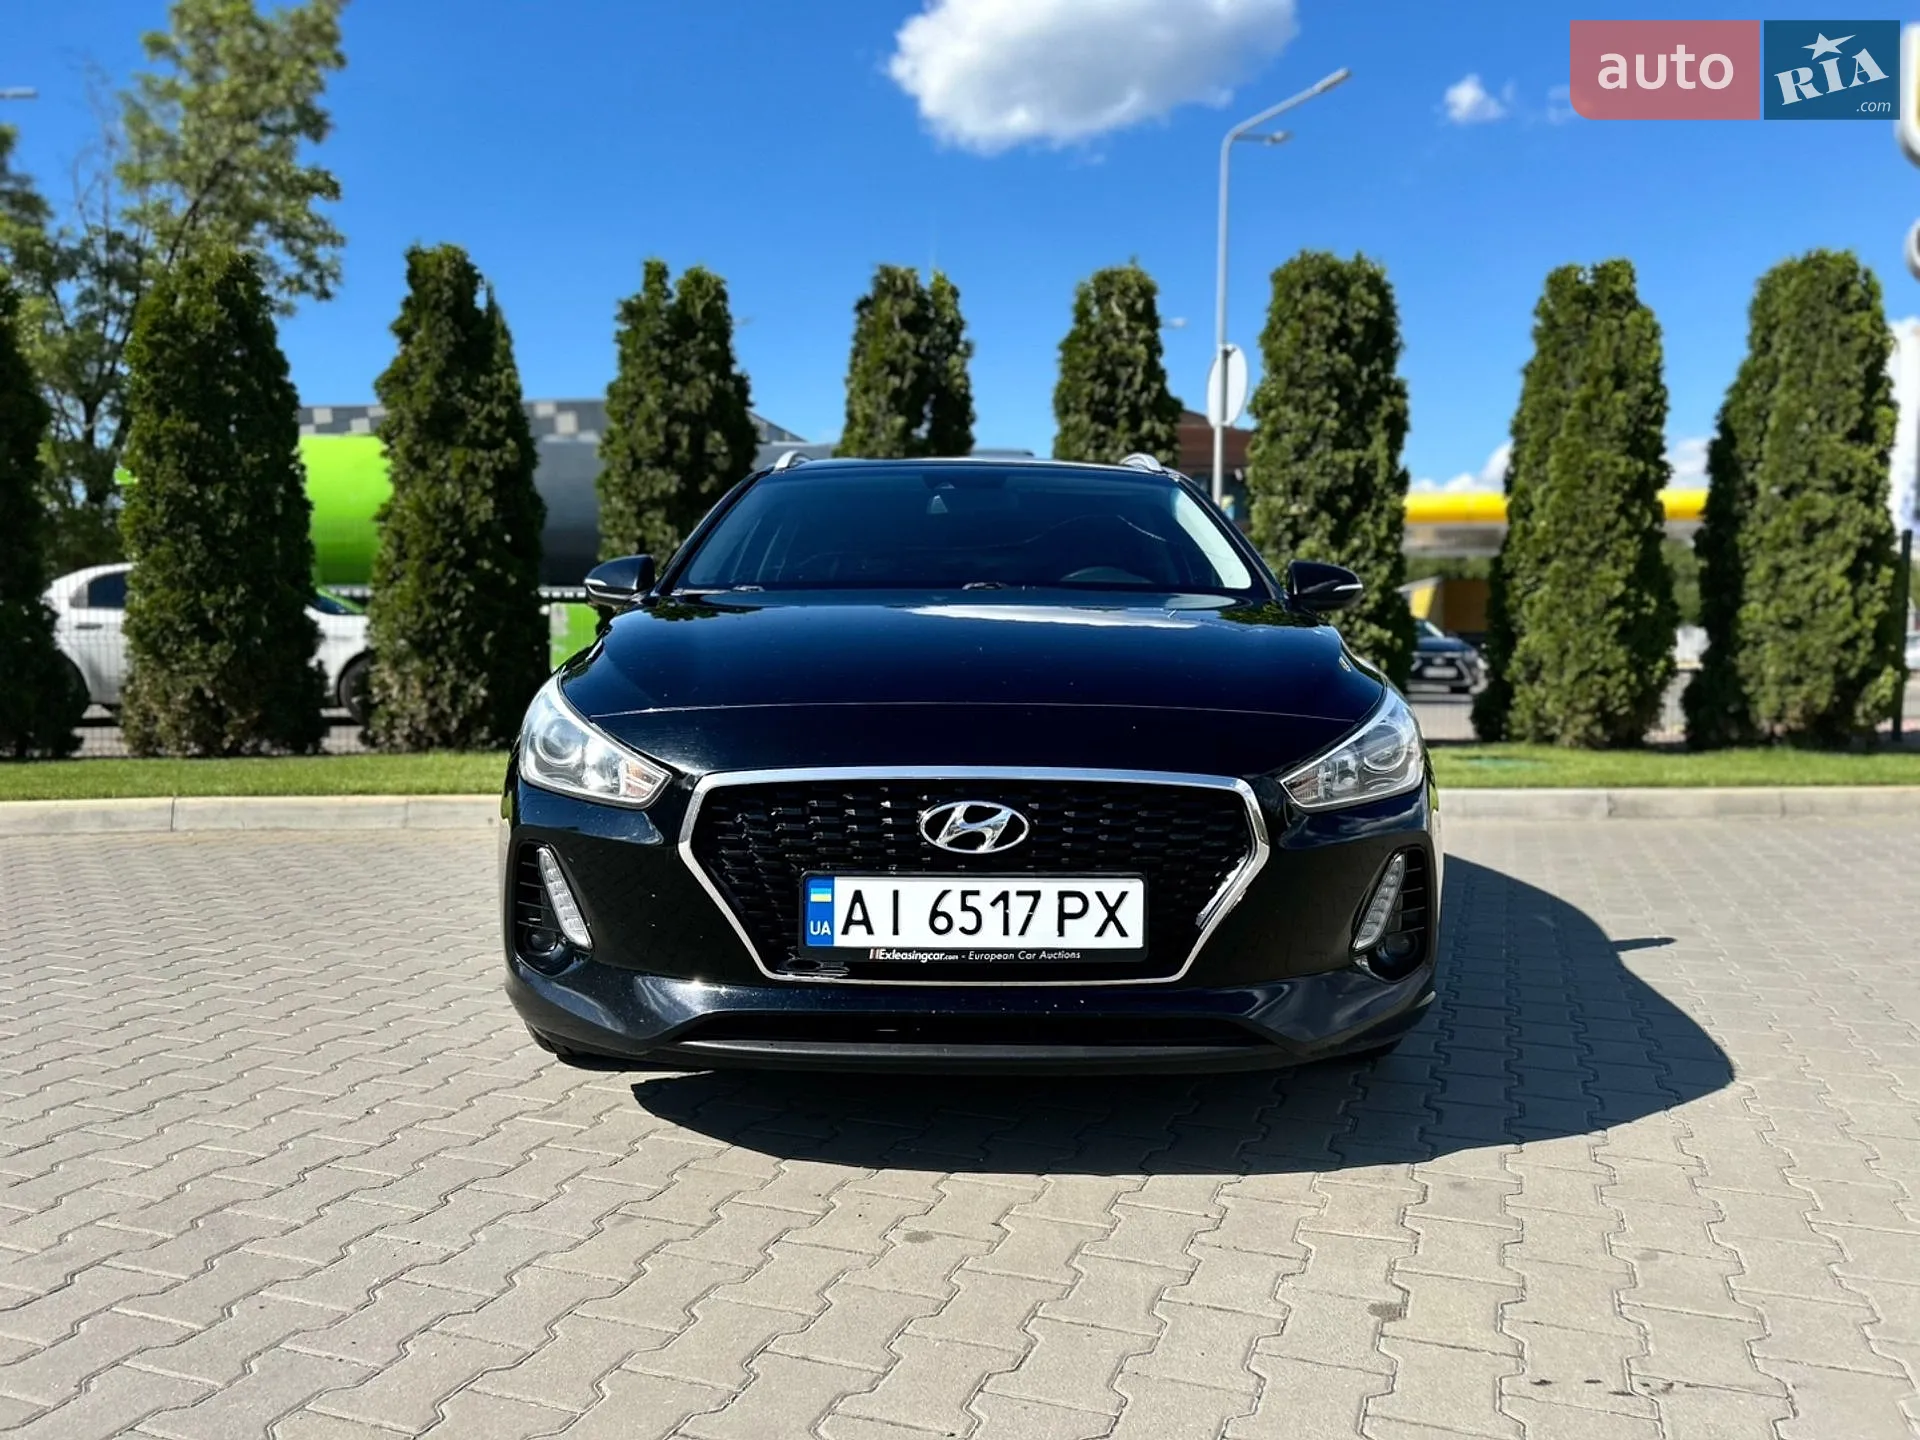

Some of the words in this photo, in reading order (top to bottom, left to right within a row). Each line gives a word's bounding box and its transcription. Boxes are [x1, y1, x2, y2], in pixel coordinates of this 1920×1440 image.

[841, 889, 900, 936] AI
[928, 889, 1042, 937] 6517
[1057, 890, 1129, 938] PX
[809, 920, 832, 936] UA
[968, 951, 1014, 963] European
[1018, 950, 1037, 960] Car
[1039, 950, 1081, 960] Auctions
